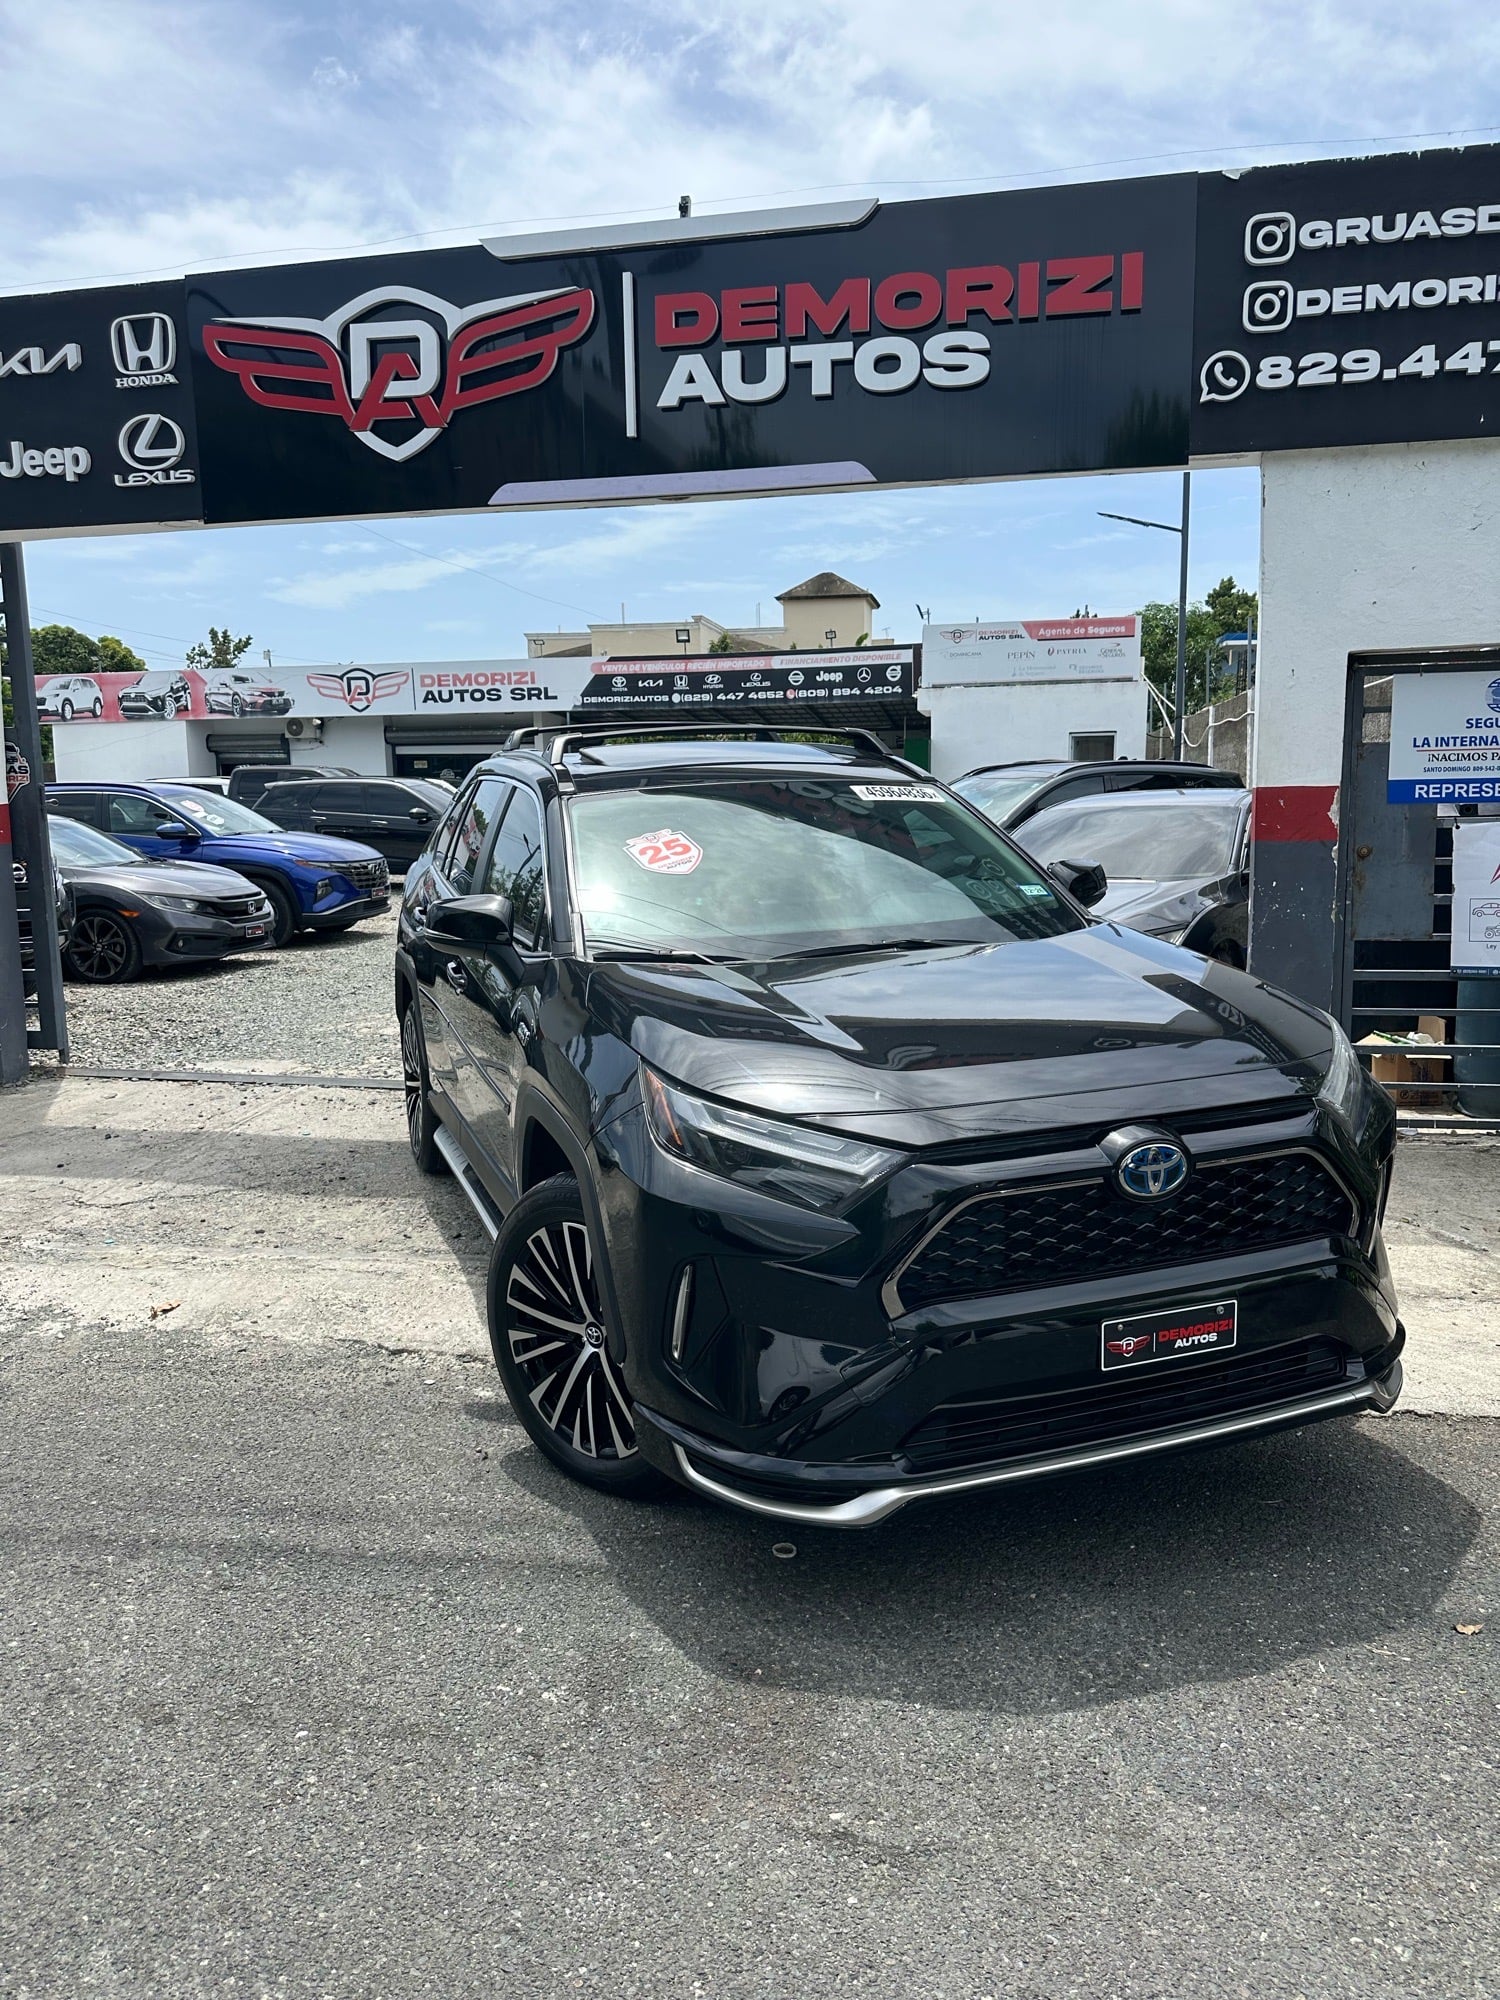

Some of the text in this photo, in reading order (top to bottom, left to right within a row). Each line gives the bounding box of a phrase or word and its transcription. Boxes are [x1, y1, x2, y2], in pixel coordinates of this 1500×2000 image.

[1299, 204, 1500, 249] GRUASD
[655, 251, 1144, 348] DEMORIZI
[1296, 274, 1500, 318] DEMORI
[656, 330, 991, 410] AUTOS
[115, 372, 179, 389] HONDA
[0, 440, 92, 483] Jeep
[114, 469, 196, 488] LEXUS
[1038, 624, 1126, 637] Agente de Seguros
[420, 671, 536, 688] DEMORIZI
[816, 671, 843, 683] Jeep
[422, 686, 558, 704] AUTOS SRL
[681, 692, 713, 702] (829)
[717, 692, 745, 701] 447
[796, 688, 829, 698] (809)
[832, 687, 861, 696] 894
[864, 685, 903, 694] 4204
[1413, 737, 1431, 748] LA
[1427, 751, 1488, 762] ¡NACIMOS
[638, 837, 692, 865] 25
[1158, 1318, 1233, 1342] DEMORIZI
[1174, 1332, 1218, 1348] AUTOS
